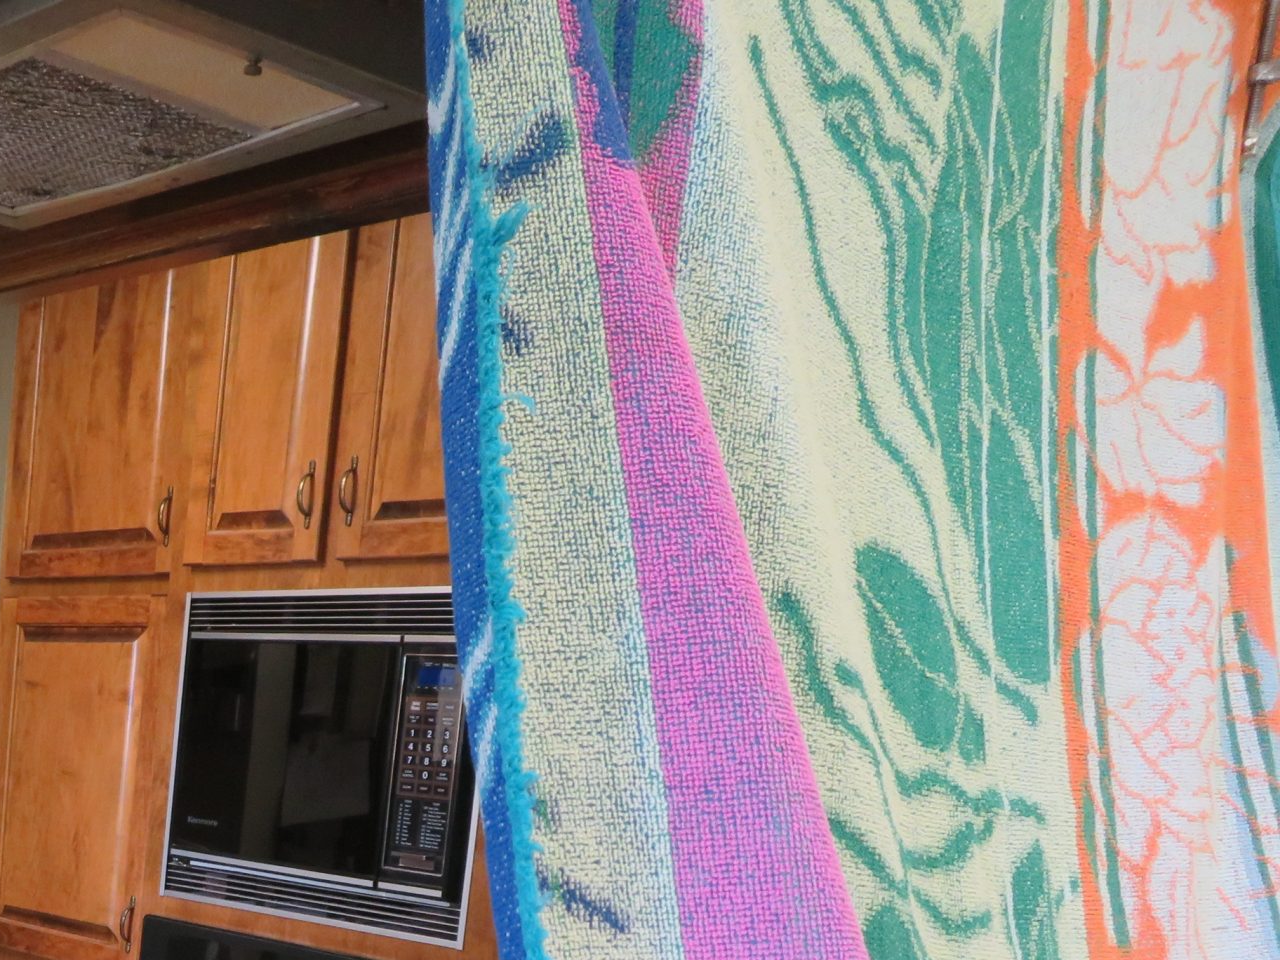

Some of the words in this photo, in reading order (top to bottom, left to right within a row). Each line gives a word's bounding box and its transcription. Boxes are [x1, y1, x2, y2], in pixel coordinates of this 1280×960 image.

[410, 729, 415, 737] 1
[427, 729, 433, 738] 2
[444, 730, 450, 739] 3
[407, 742, 414, 751] 4
[425, 743, 431, 752] 5
[442, 745, 449, 754] 6
[407, 756, 413, 764] 7
[423, 757, 430, 766] 8
[441, 758, 447, 767] 9
[422, 770, 429, 779] 0
